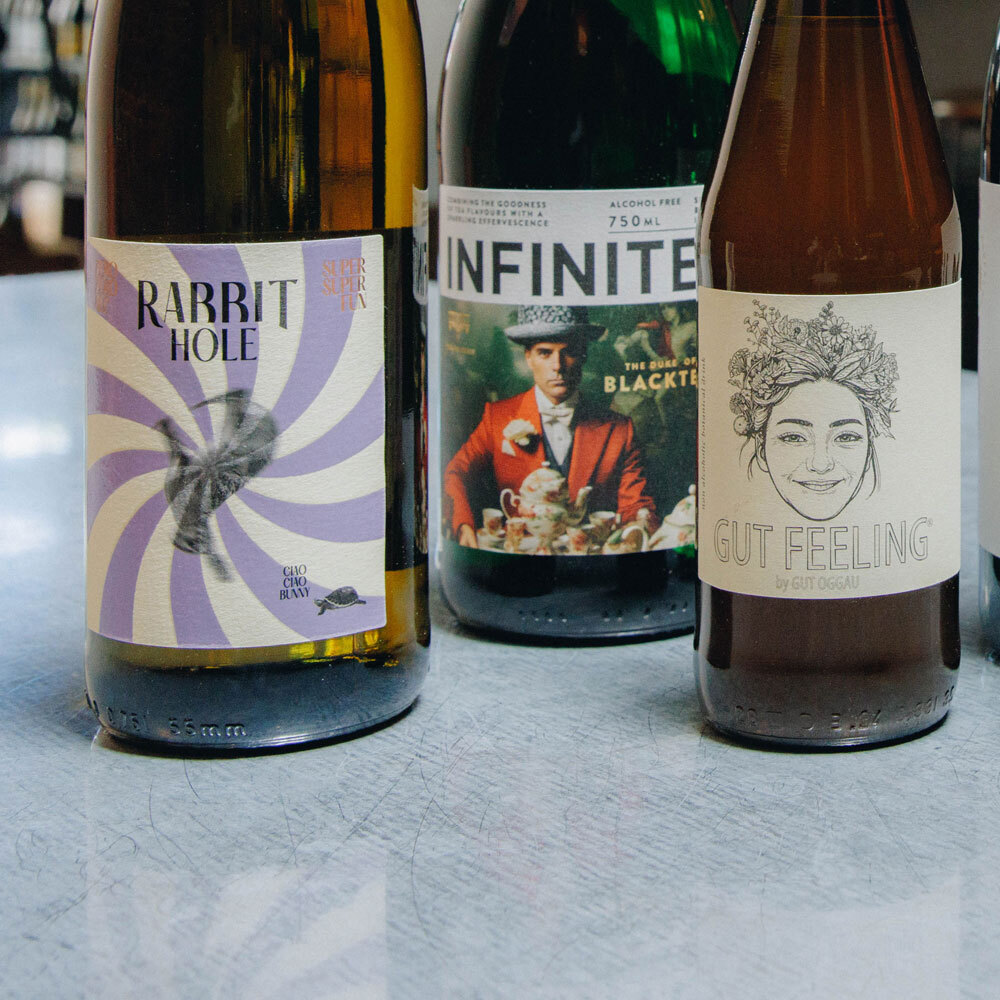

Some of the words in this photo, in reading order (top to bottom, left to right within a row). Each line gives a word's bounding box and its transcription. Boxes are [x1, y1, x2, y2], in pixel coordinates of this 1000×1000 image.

[497, 200, 546, 208] GOODNESS
[610, 200, 656, 208] ALCOHOL
[660, 198, 681, 206] FREE
[478, 218, 548, 227] EFFERVESCENCE
[322, 257, 366, 277] SUPER
[448, 236, 696, 297] INFINITE
[322, 275, 366, 296] SUPER
[138, 279, 298, 330] RABBIT
[341, 293, 366, 312] FUN
[171, 328, 258, 362] HOLE
[625, 362, 646, 371] THE
[650, 359, 677, 369] DUKE
[714, 518, 773, 568] GUT
[283, 564, 306, 576] CIAO
[283, 576, 306, 588] CIAO
[776, 575, 789, 593] by
[792, 576, 815, 590] GUT
[818, 575, 860, 590] OGGAU
[280, 586, 310, 600] BUNNY
